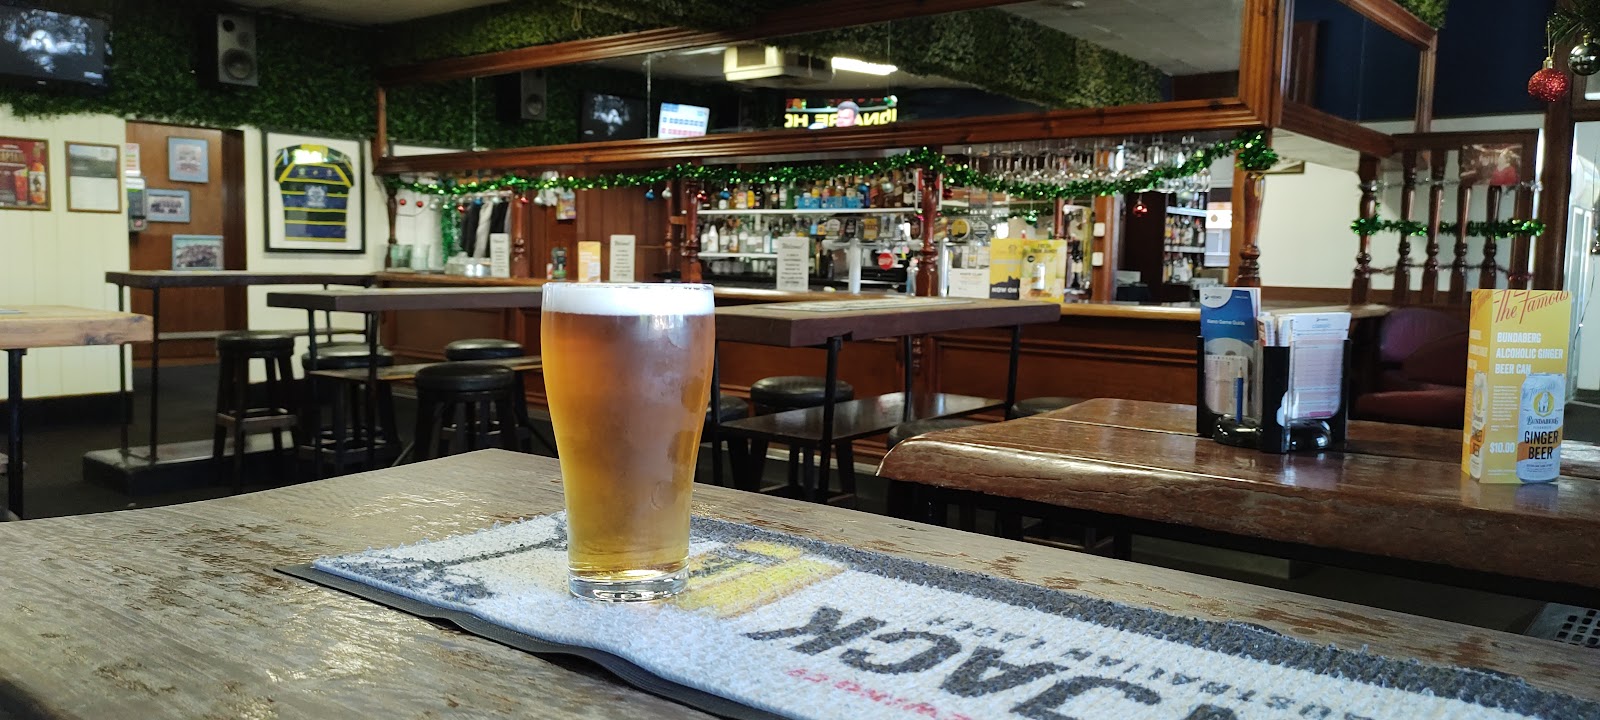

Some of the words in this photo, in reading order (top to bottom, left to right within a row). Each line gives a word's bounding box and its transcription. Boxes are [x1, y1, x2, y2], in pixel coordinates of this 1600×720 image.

[1493, 290, 1518, 323] The
[1497, 332, 1542, 343] BUNDABERG
[1495, 347, 1537, 359] ALCOHOLIC
[1537, 348, 1564, 359] GINGER
[1494, 363, 1515, 375] BEER
[1516, 363, 1532, 375] CAN
[1524, 430, 1559, 445] GINGER
[1489, 442, 1515, 454] $10.00
[1528, 446, 1553, 460] BEER
[740, 605, 1161, 720] JACK
